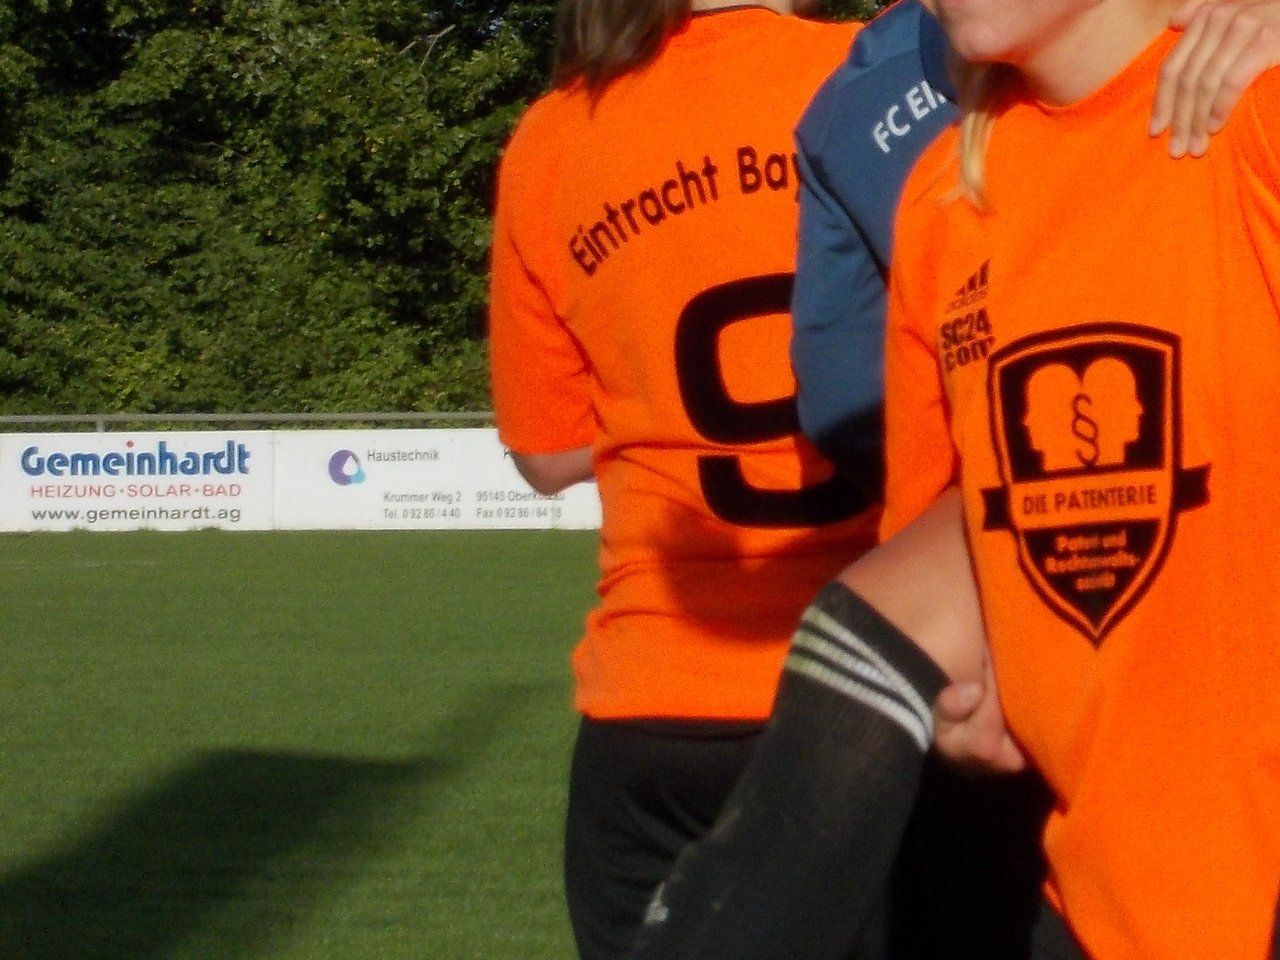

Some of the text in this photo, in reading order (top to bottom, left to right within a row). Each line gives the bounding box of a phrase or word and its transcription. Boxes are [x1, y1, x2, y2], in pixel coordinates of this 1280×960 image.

[873, 105, 911, 153] FC
[568, 154, 719, 277] Eintracht
[675, 271, 877, 528] 9
[21, 439, 251, 477] Gemeinhardt
[367, 449, 440, 462] Haustechnik
[383, 491, 461, 504] Krummer Weg 2
[1055, 485, 1157, 512] PATENTERIE
[31, 506, 242, 523] www.gemeinhardt.ag
